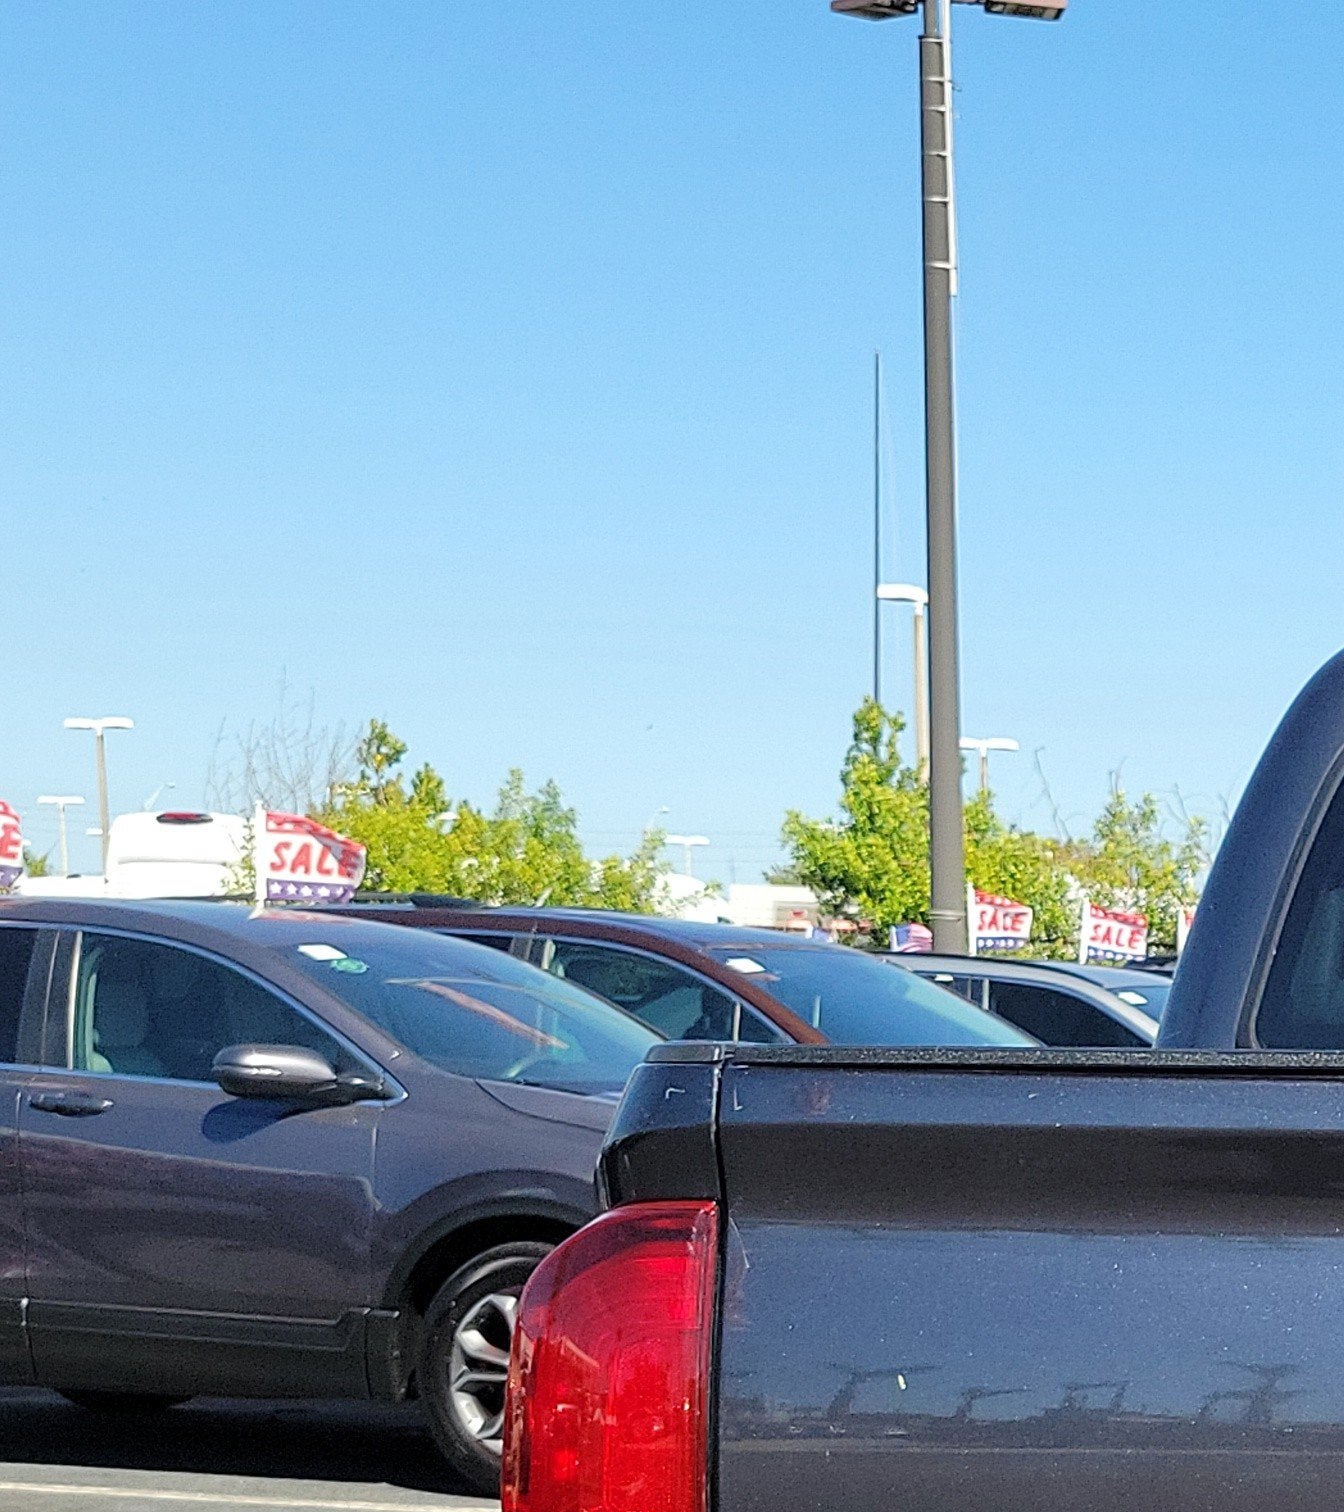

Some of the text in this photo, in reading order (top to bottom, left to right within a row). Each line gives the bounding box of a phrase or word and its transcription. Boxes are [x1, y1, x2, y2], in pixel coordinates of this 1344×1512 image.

[269, 841, 360, 879] SALE
[977, 909, 1029, 933] SALE
[1090, 923, 1146, 950] SALE
